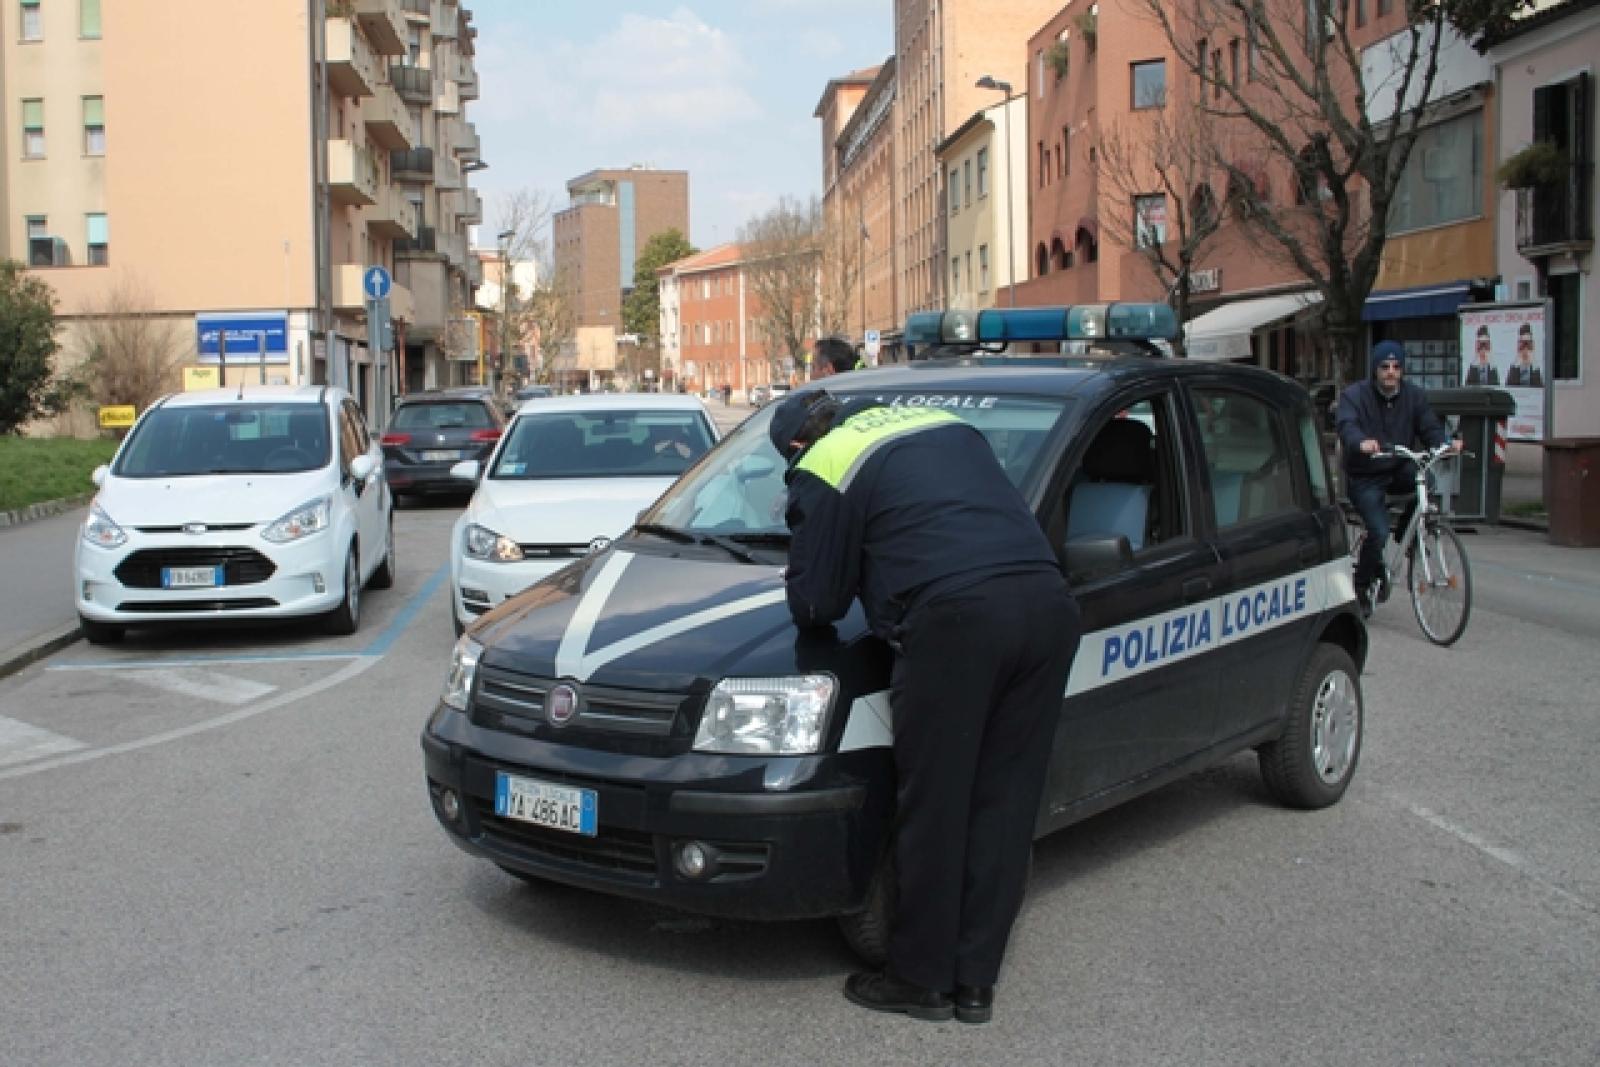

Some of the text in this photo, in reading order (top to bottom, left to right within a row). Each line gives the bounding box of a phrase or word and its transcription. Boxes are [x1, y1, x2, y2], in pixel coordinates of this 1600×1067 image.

[889, 394, 998, 408] LOCALE
[1103, 578, 1307, 676] POLIZIA LOCALE
